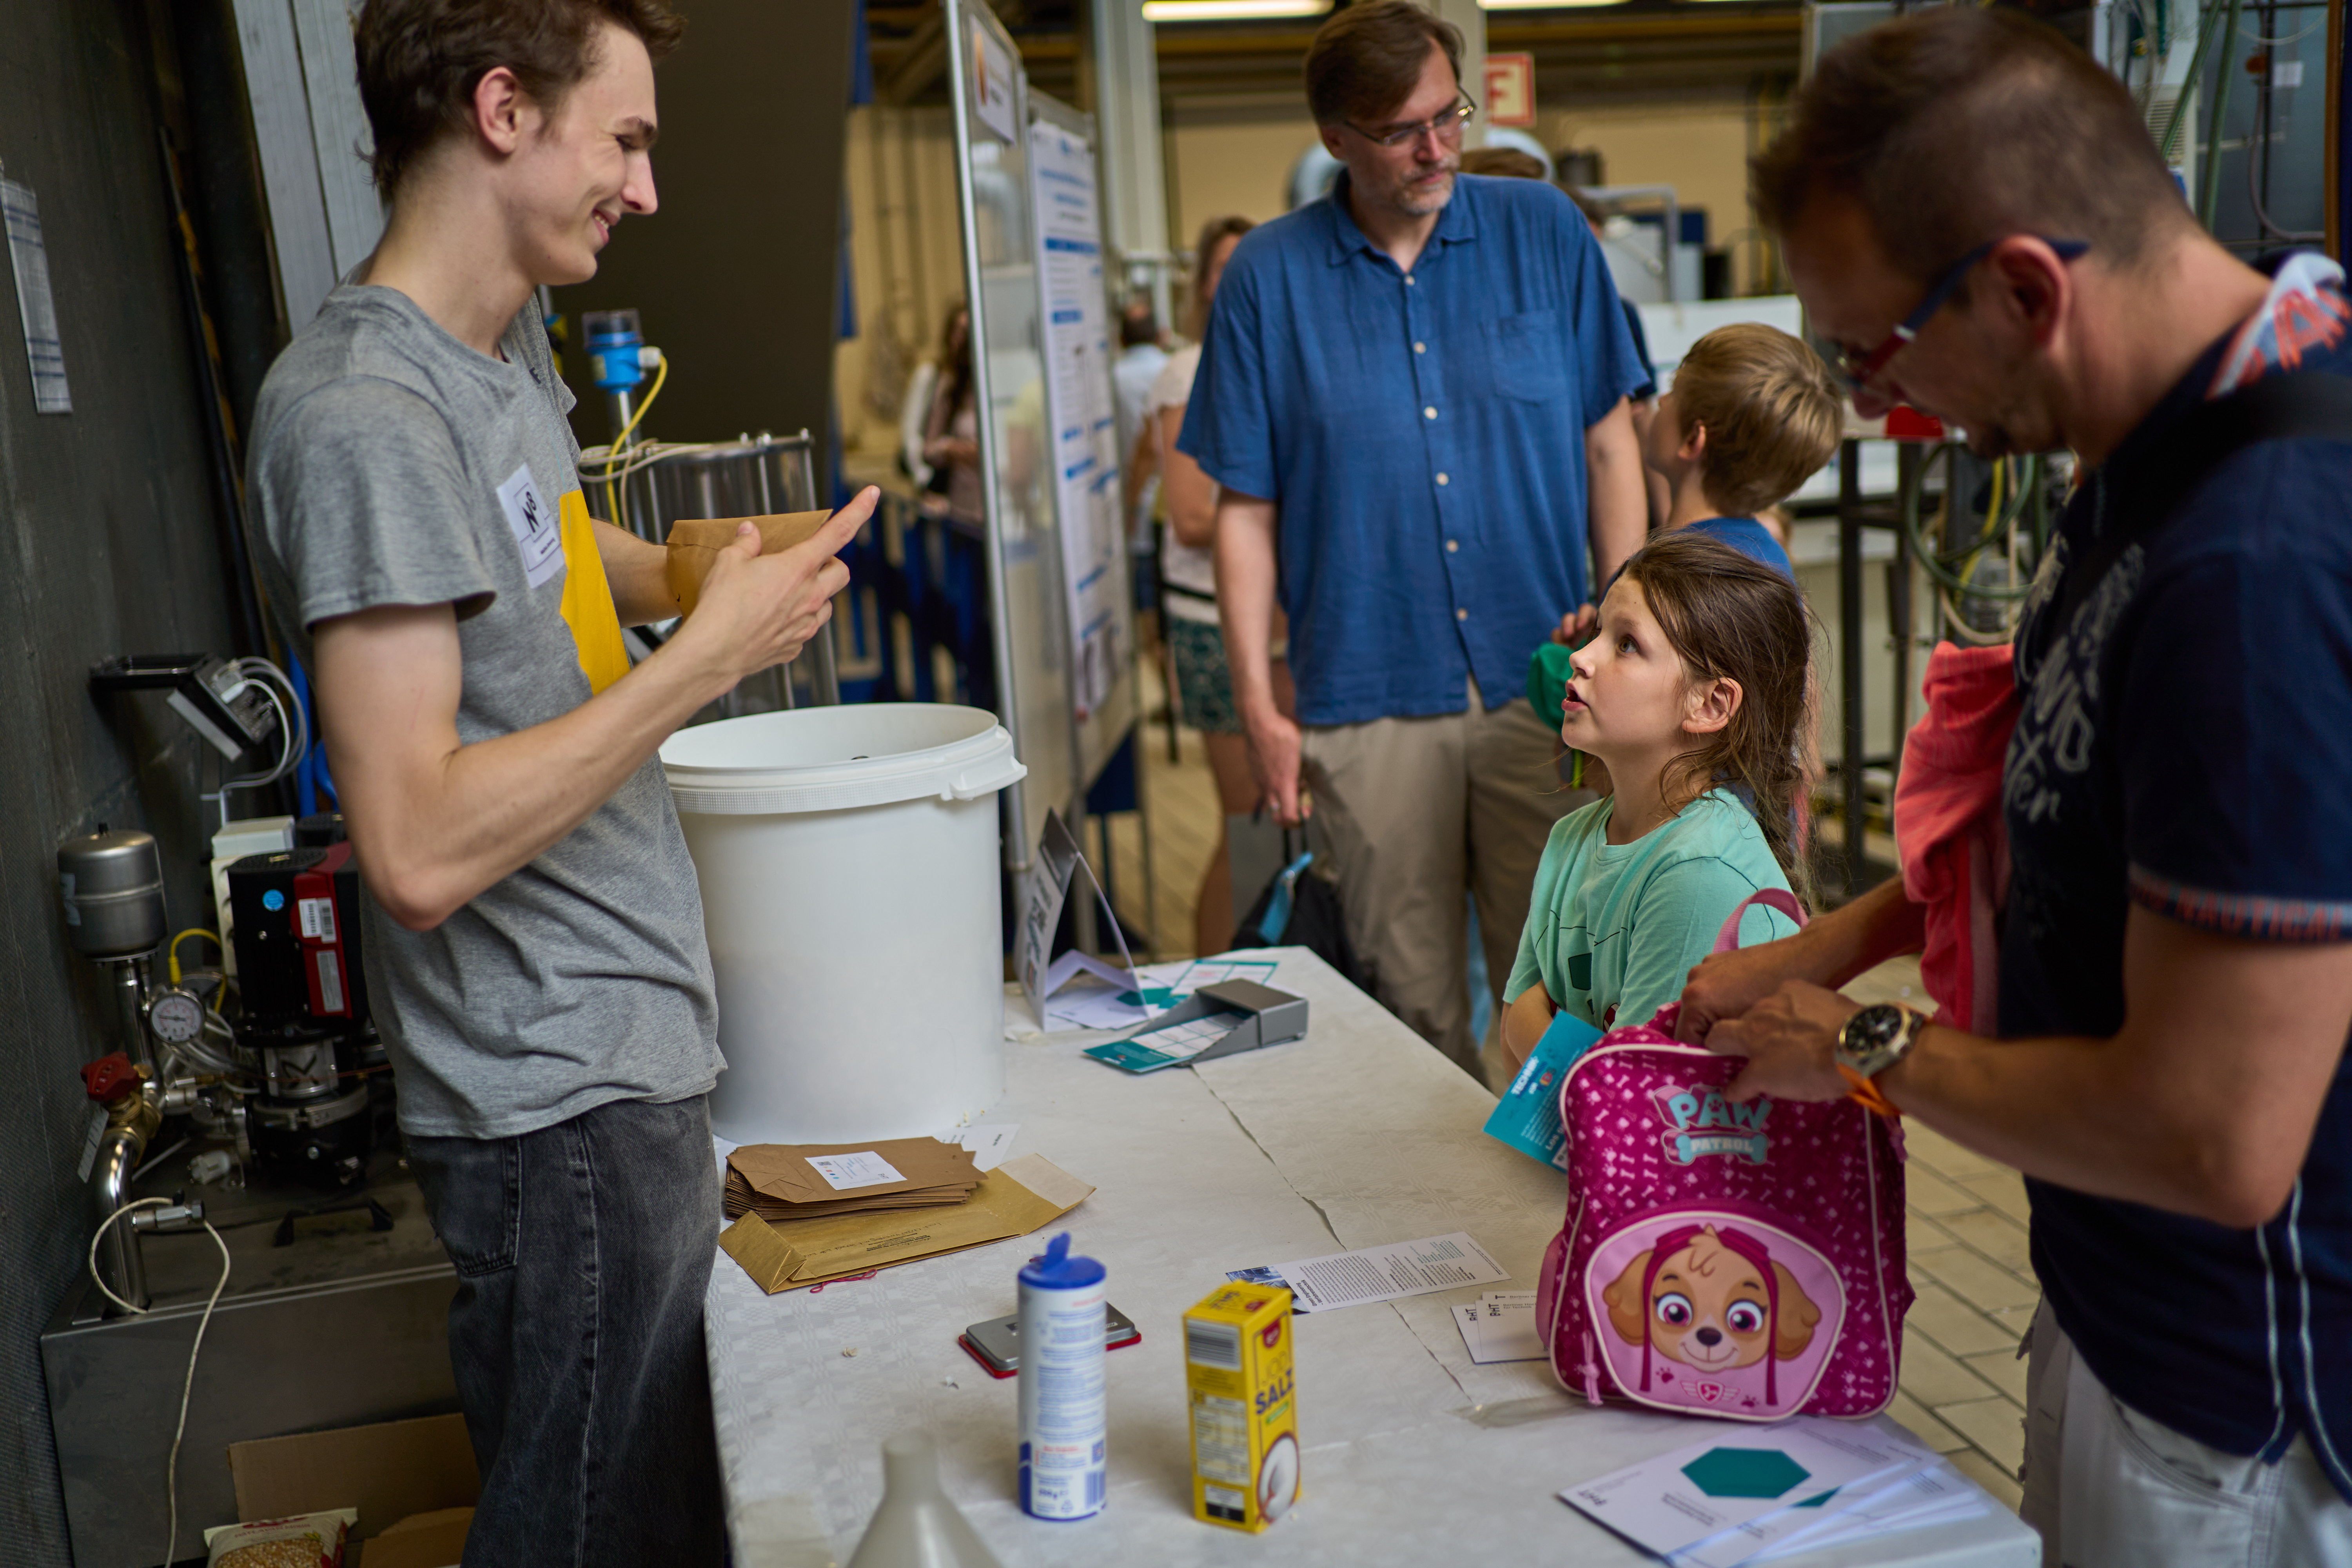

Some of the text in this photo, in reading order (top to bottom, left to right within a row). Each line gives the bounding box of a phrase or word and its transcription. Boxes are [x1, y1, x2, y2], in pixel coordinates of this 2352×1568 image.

[1668, 1092, 1773, 1131] PAW
[1690, 1137, 1754, 1152] PATROL
[1296, 1282, 1318, 1307] Green Engineering
[1255, 1368, 1294, 1415] SALZ
